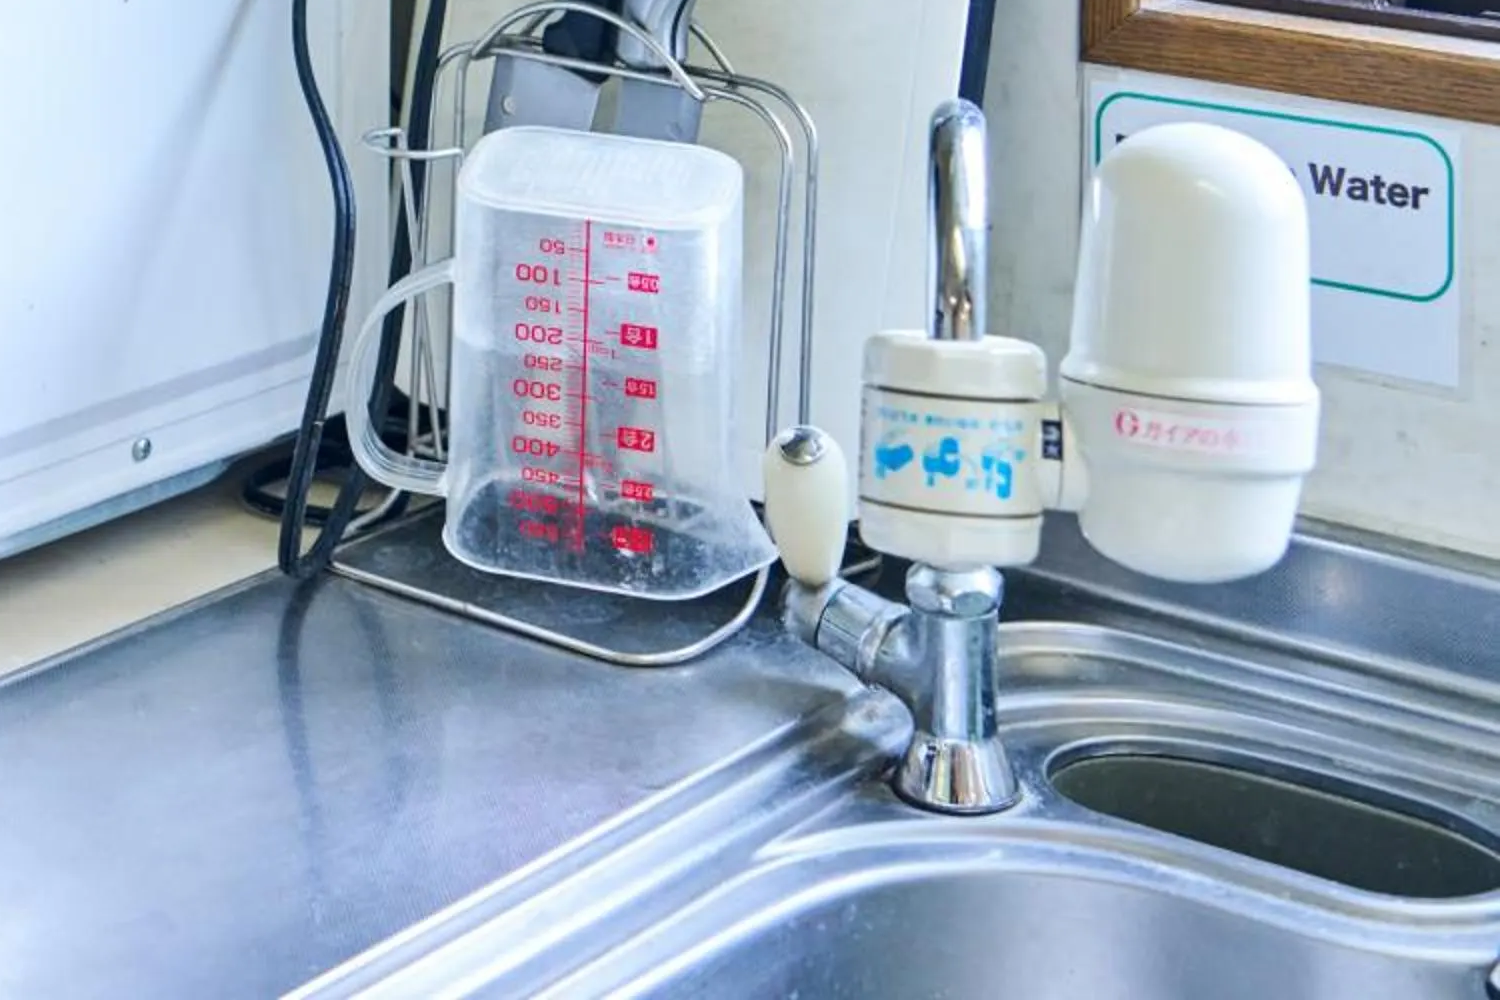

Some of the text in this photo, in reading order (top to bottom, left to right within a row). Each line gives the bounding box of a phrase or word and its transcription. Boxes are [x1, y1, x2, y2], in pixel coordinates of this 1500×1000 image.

[1308, 162, 1430, 210] Water
[539, 237, 565, 255] 50
[515, 262, 561, 286] 100
[525, 295, 561, 315] 150
[514, 322, 563, 345] 200
[523, 353, 563, 372] 250
[512, 378, 562, 401] 300
[522, 410, 561, 429] 350
[511, 436, 560, 458] 400
[521, 467, 559, 484] 450
